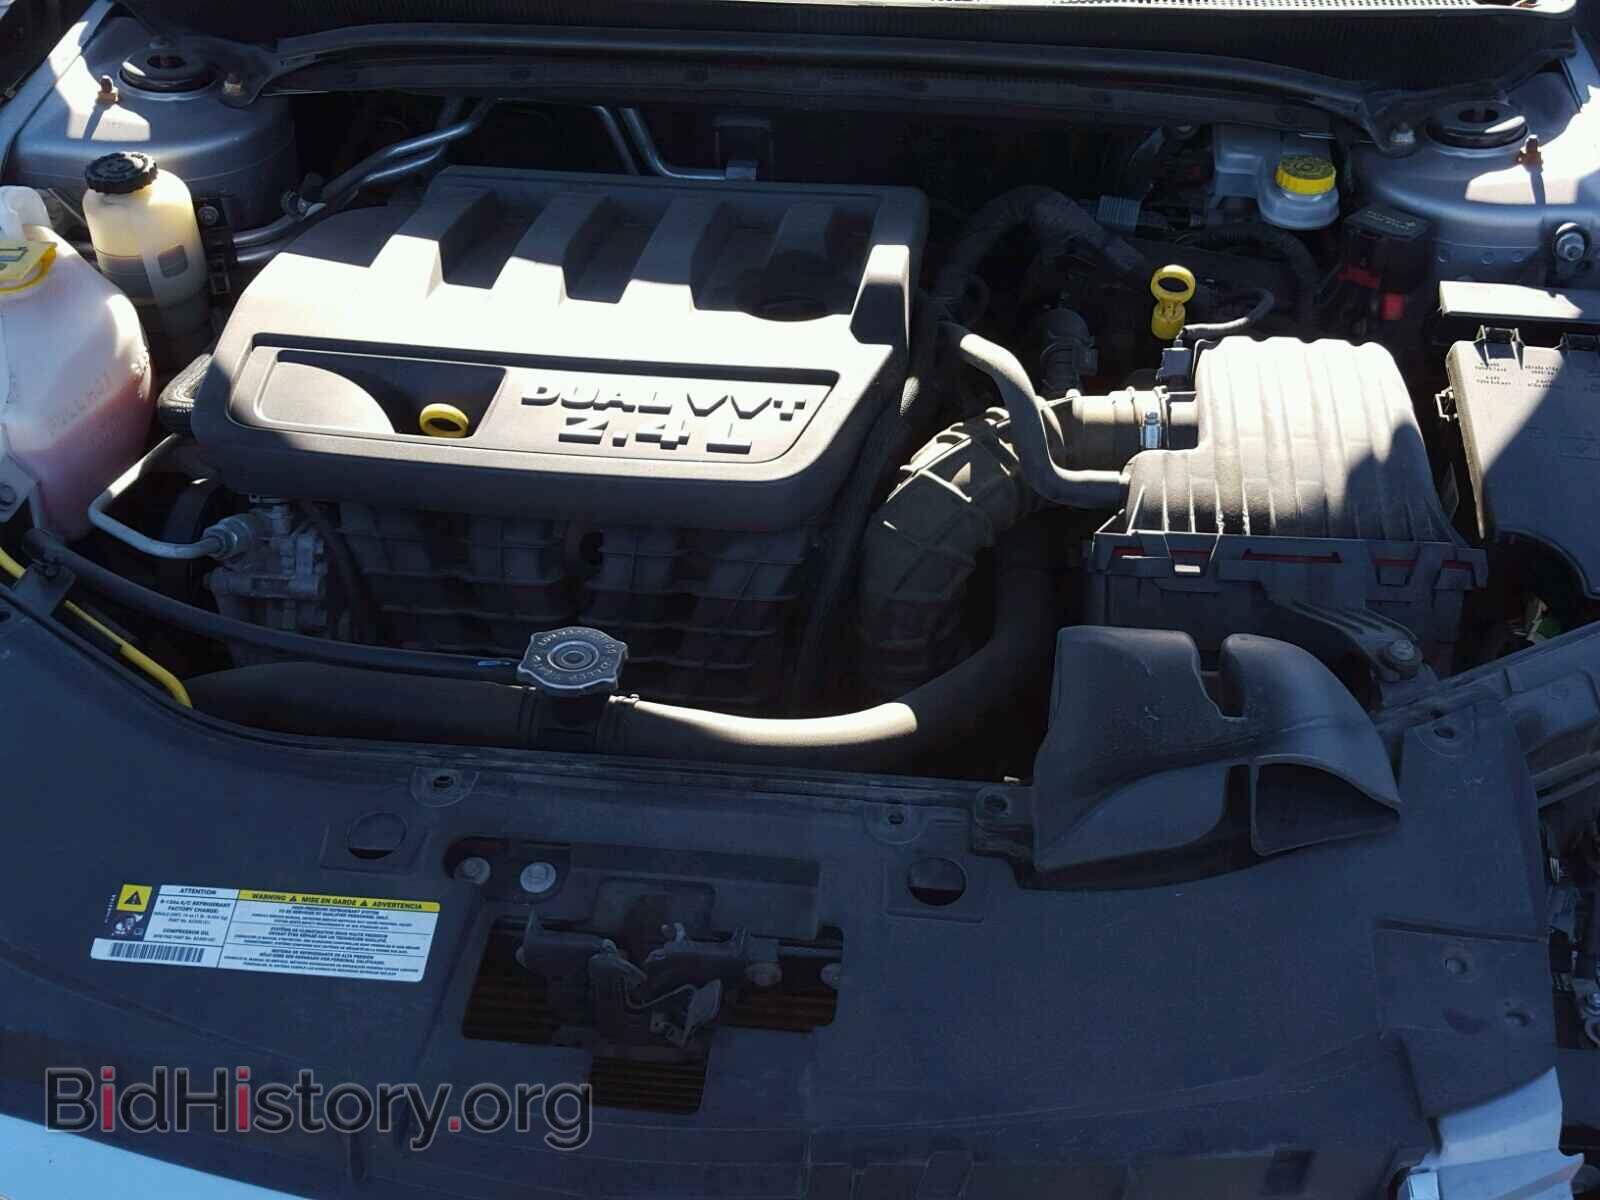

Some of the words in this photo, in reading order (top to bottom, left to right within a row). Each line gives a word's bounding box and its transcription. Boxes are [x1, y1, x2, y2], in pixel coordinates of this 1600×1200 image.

[521, 382, 673, 415] DUAL
[686, 389, 807, 421] VVT
[252, 893, 286, 901] WARNING
[332, 898, 357, 906] GARDE
[372, 901, 423, 909] ADVERTENCIA
